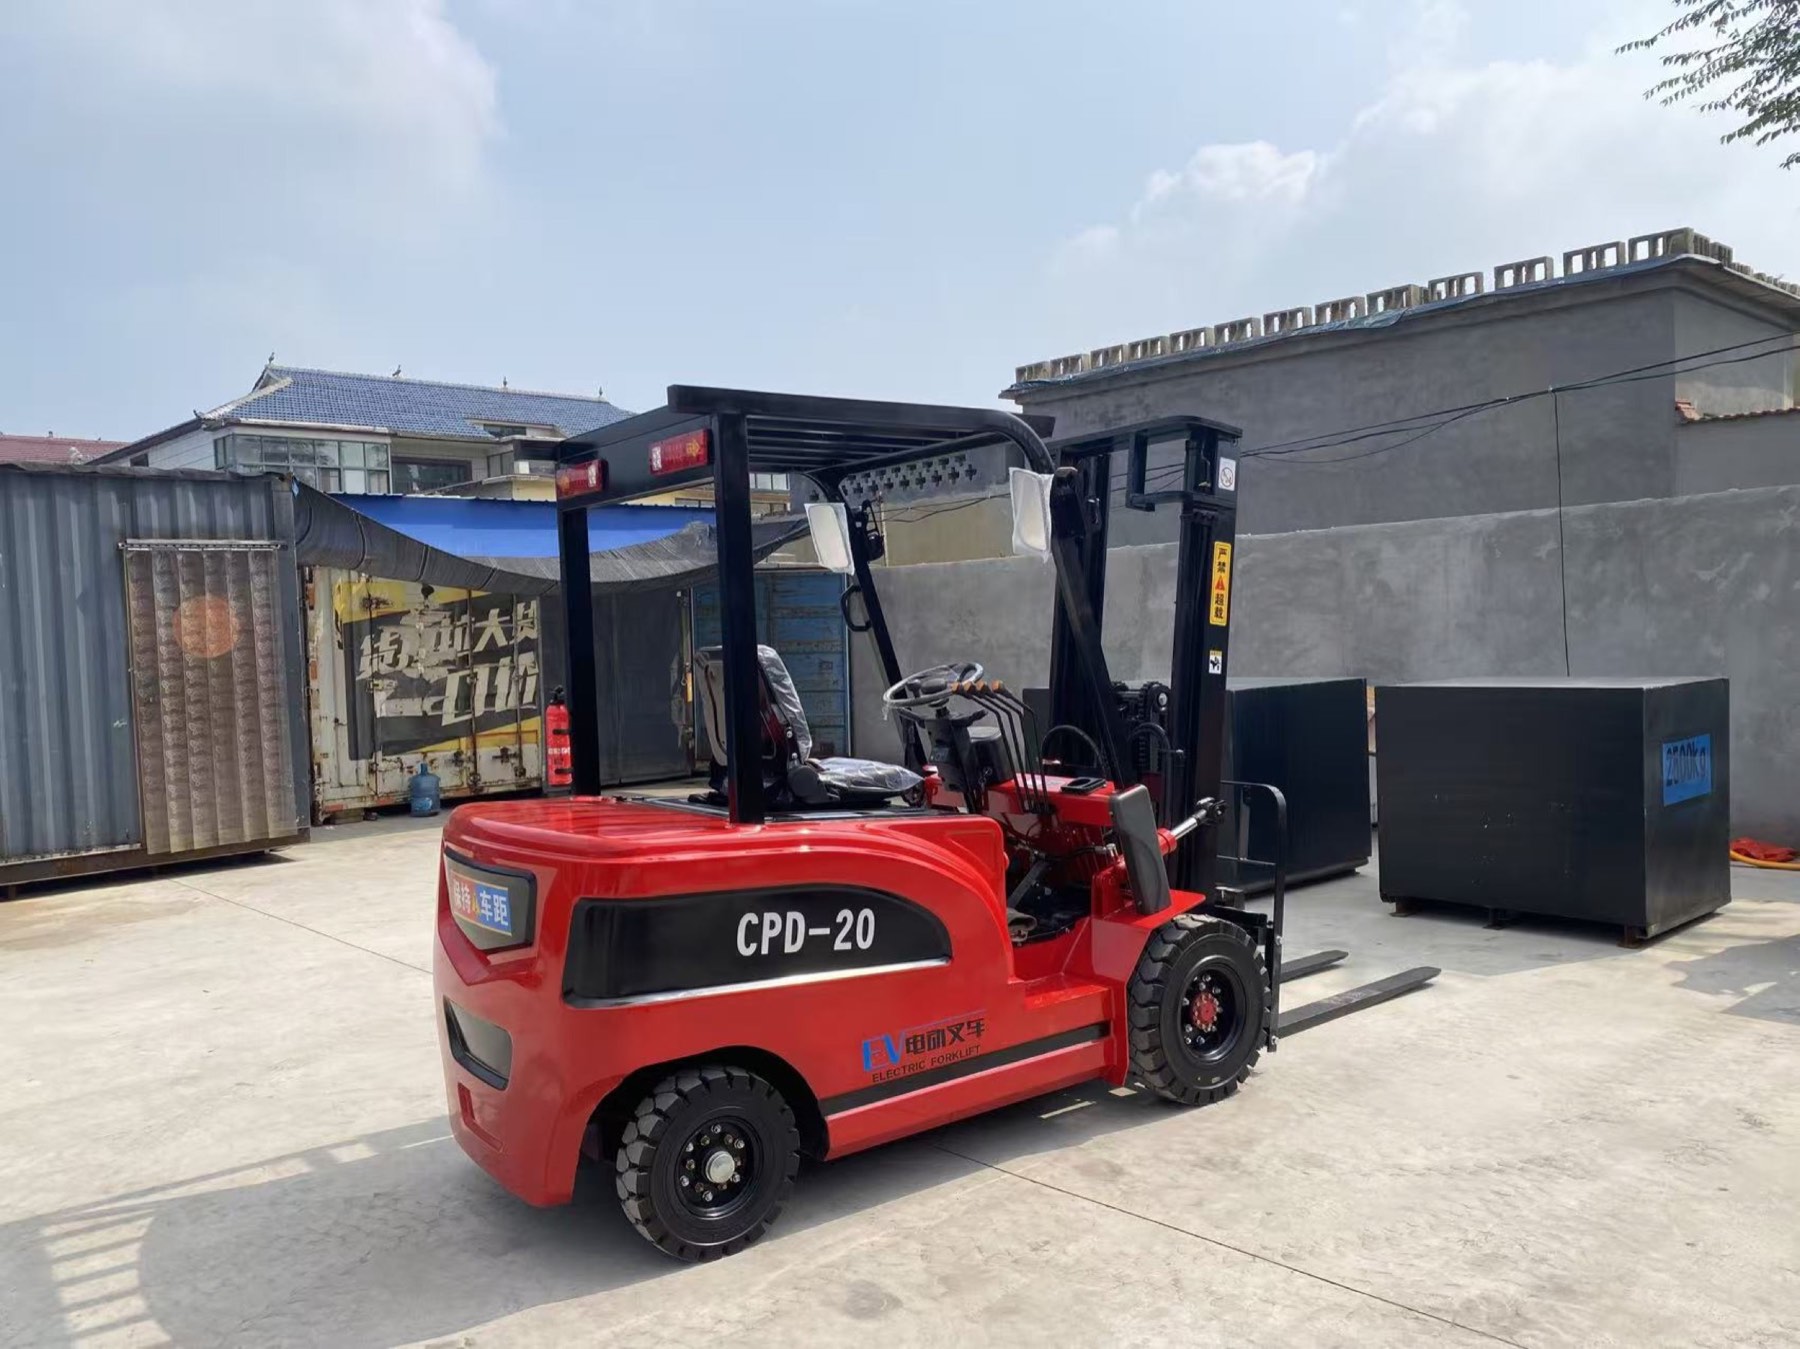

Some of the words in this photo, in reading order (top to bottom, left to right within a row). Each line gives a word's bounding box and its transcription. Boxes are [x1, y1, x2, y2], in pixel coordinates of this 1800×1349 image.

[452, 879, 471, 914] 保持
[479, 890, 509, 926] 车距
[736, 908, 876, 957] CPD-20
[862, 1032, 904, 1072] EV
[905, 1018, 985, 1055] 电动叉车
[872, 1060, 926, 1083] ELECTRIC
[930, 1045, 981, 1067] FORKLIFT
